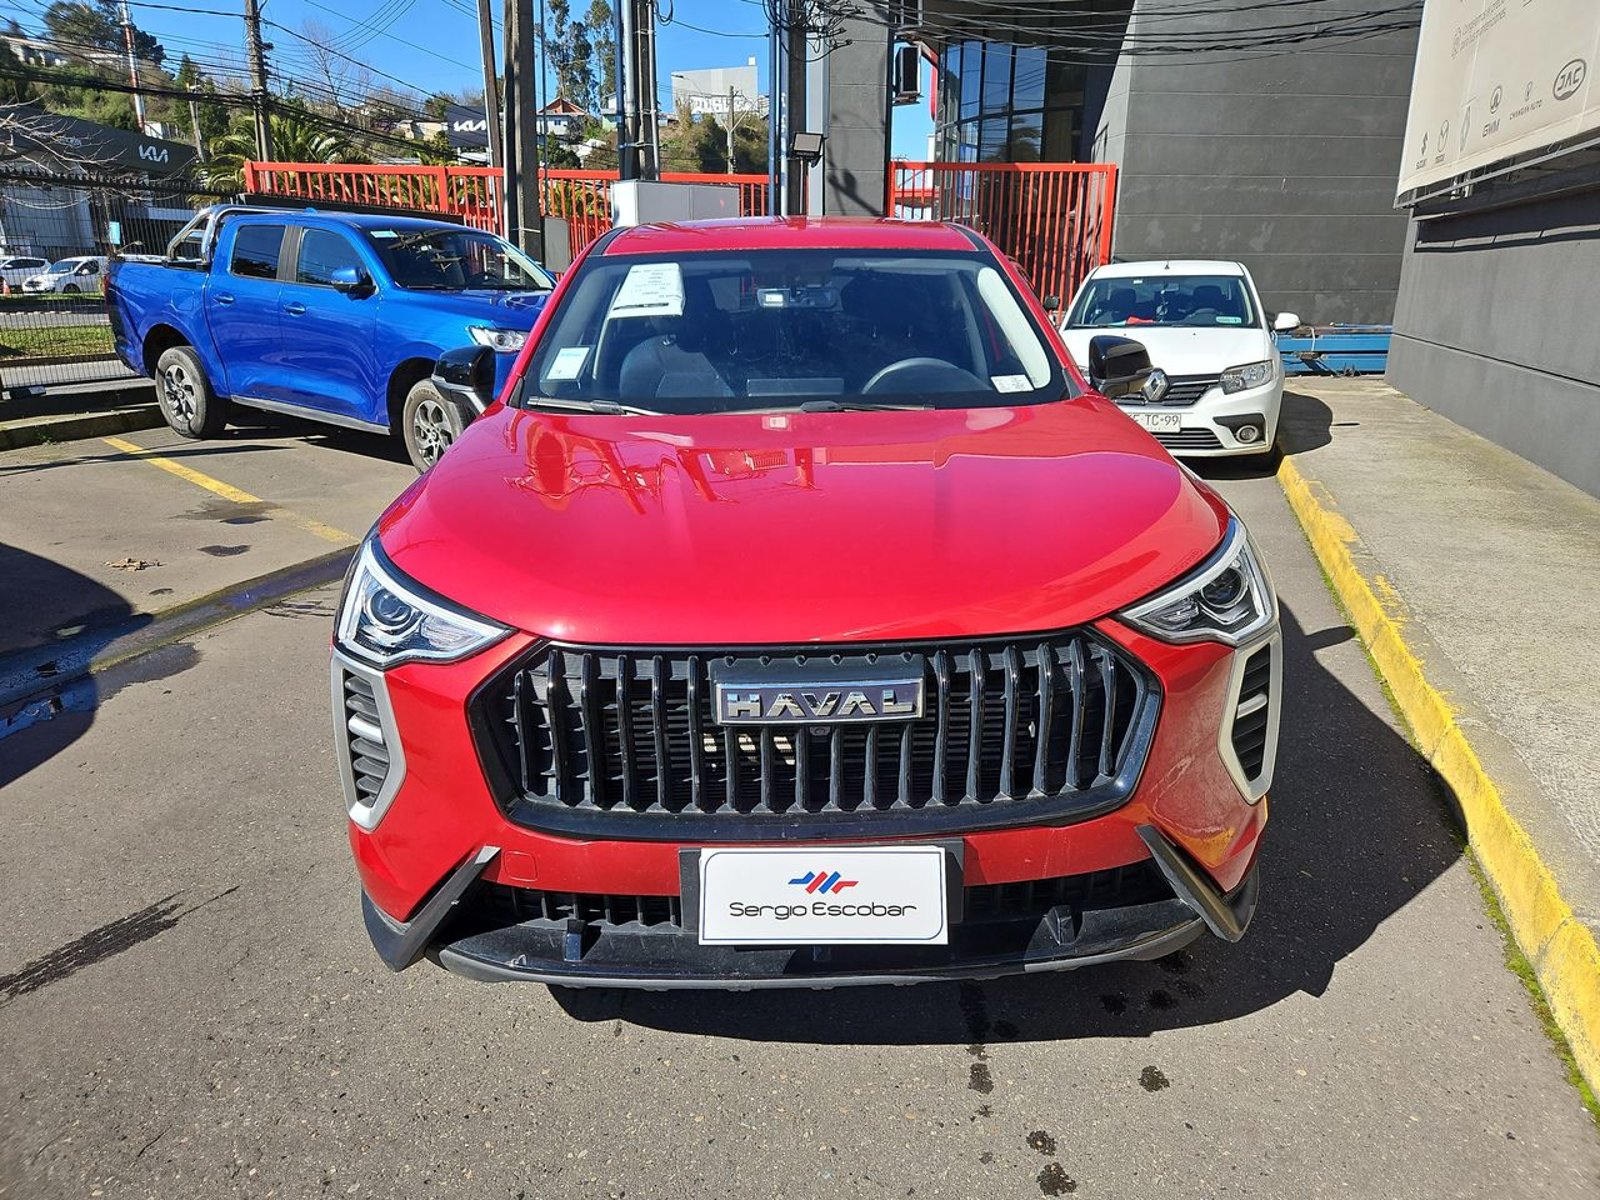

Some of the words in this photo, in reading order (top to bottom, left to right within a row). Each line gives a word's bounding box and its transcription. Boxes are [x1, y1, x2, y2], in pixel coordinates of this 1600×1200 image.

[1556, 66, 1582, 91] JAC
[453, 119, 487, 132] KIA
[138, 144, 169, 164] KIA
[726, 689, 914, 717] HAVAL
[729, 901, 807, 920] Sergio
[812, 901, 918, 918] Escobar
